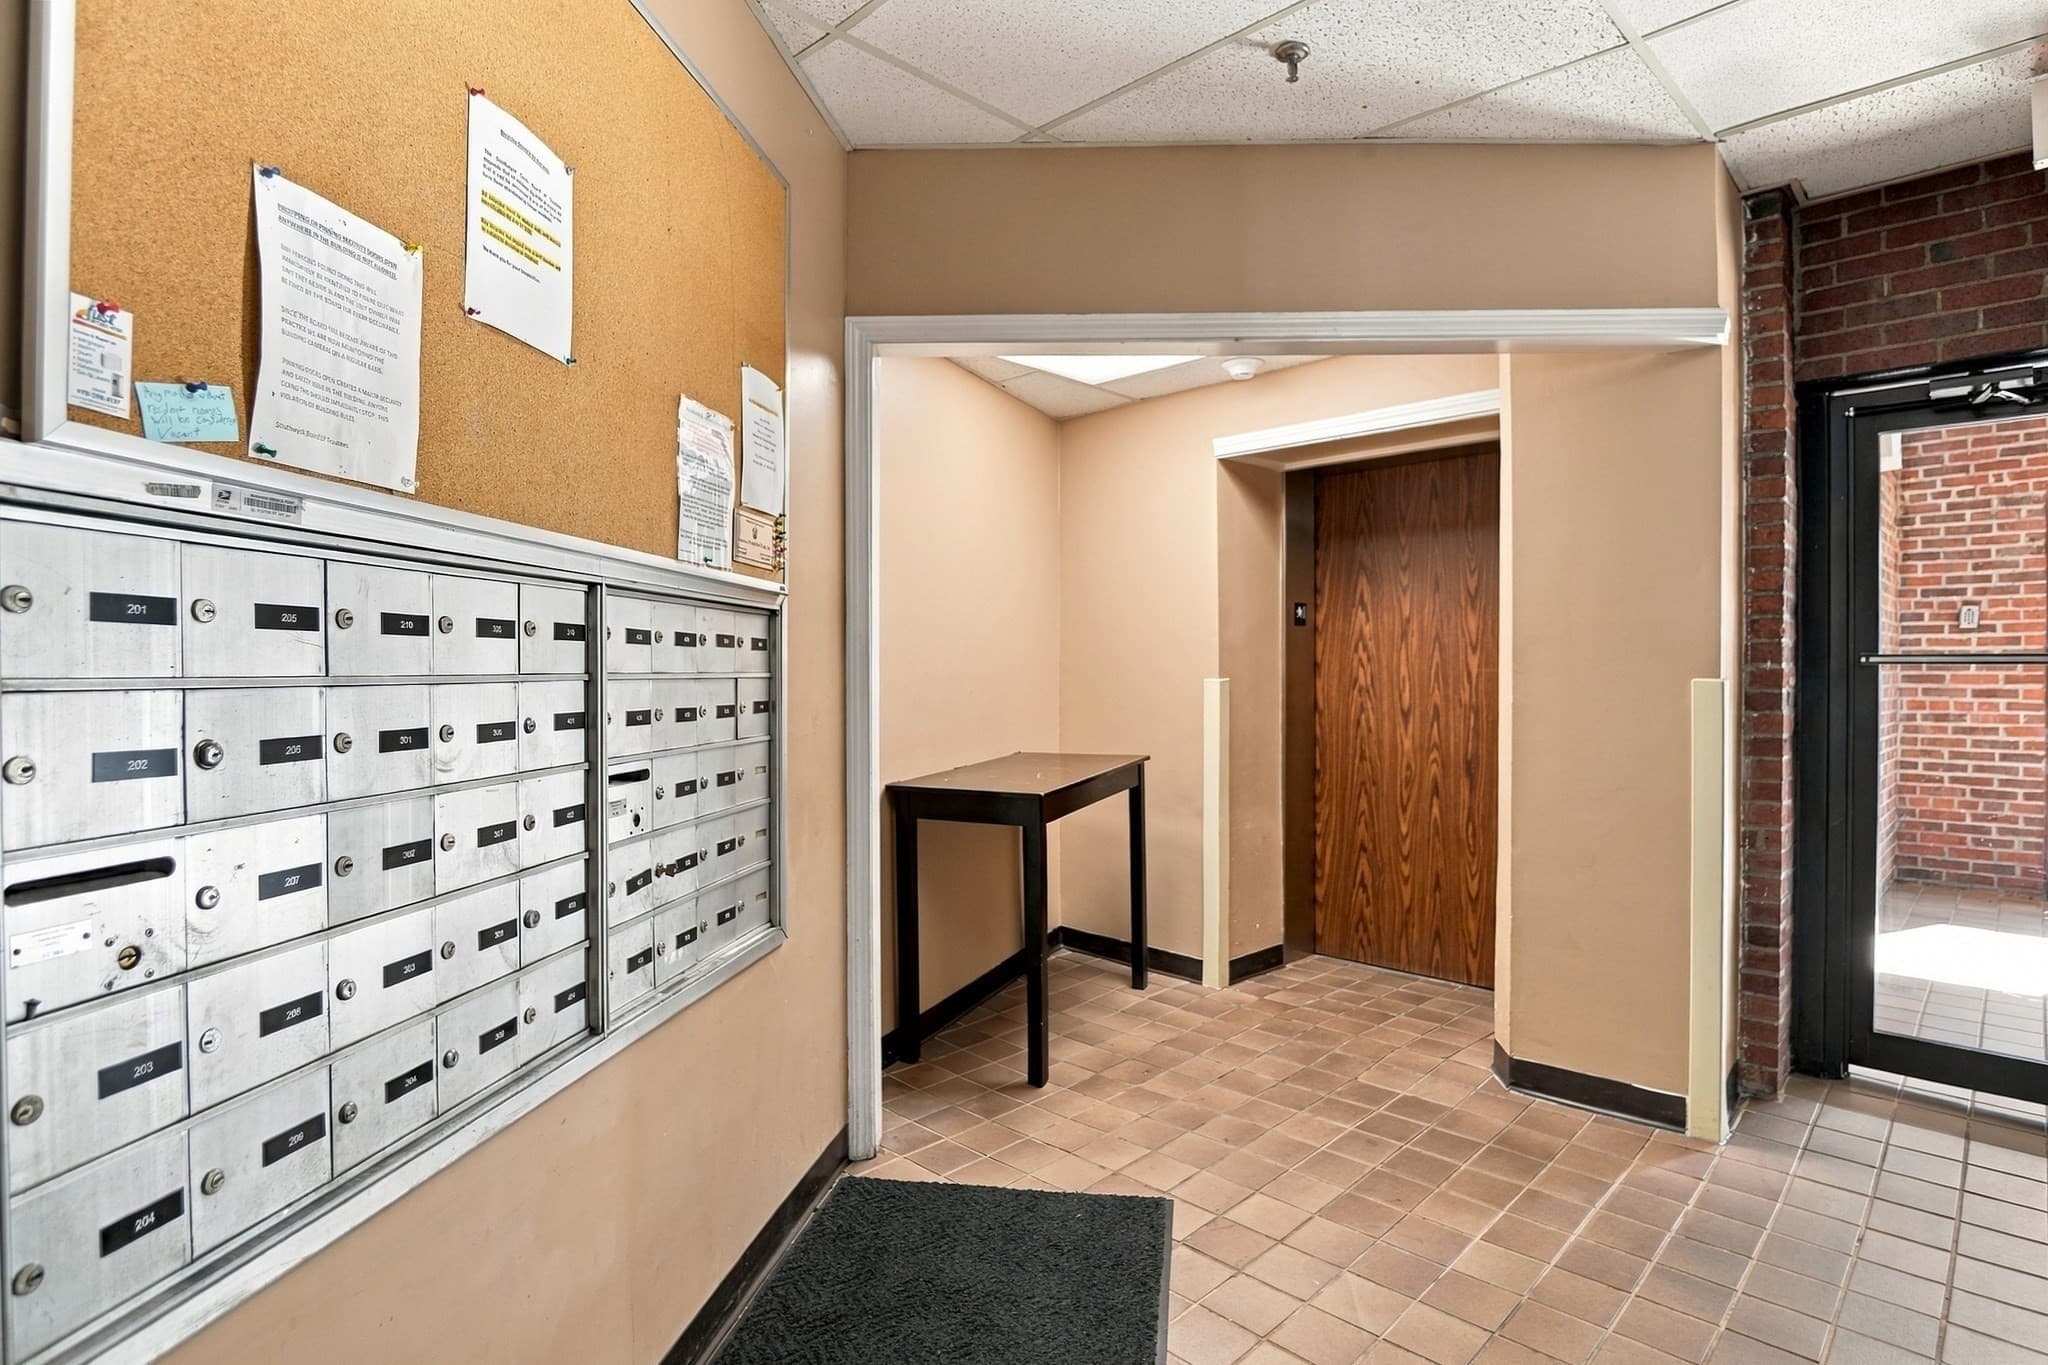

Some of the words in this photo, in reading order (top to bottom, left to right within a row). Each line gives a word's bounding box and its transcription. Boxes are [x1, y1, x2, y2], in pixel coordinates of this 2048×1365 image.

[127, 604, 146, 614] 201
[281, 613, 297, 623] 205
[400, 620, 414, 629] 210
[400, 736, 412, 744] 301
[285, 744, 301, 755] 206
[128, 759, 148, 771] 202
[403, 849, 416, 859] 302
[284, 875, 300, 887] 207
[403, 963, 416, 974] 303
[286, 1007, 301, 1021] 208
[134, 1061, 154, 1078] 203
[405, 1075, 417, 1087] 304
[288, 1131, 304, 1147] 209
[135, 1211, 155, 1232] 204
